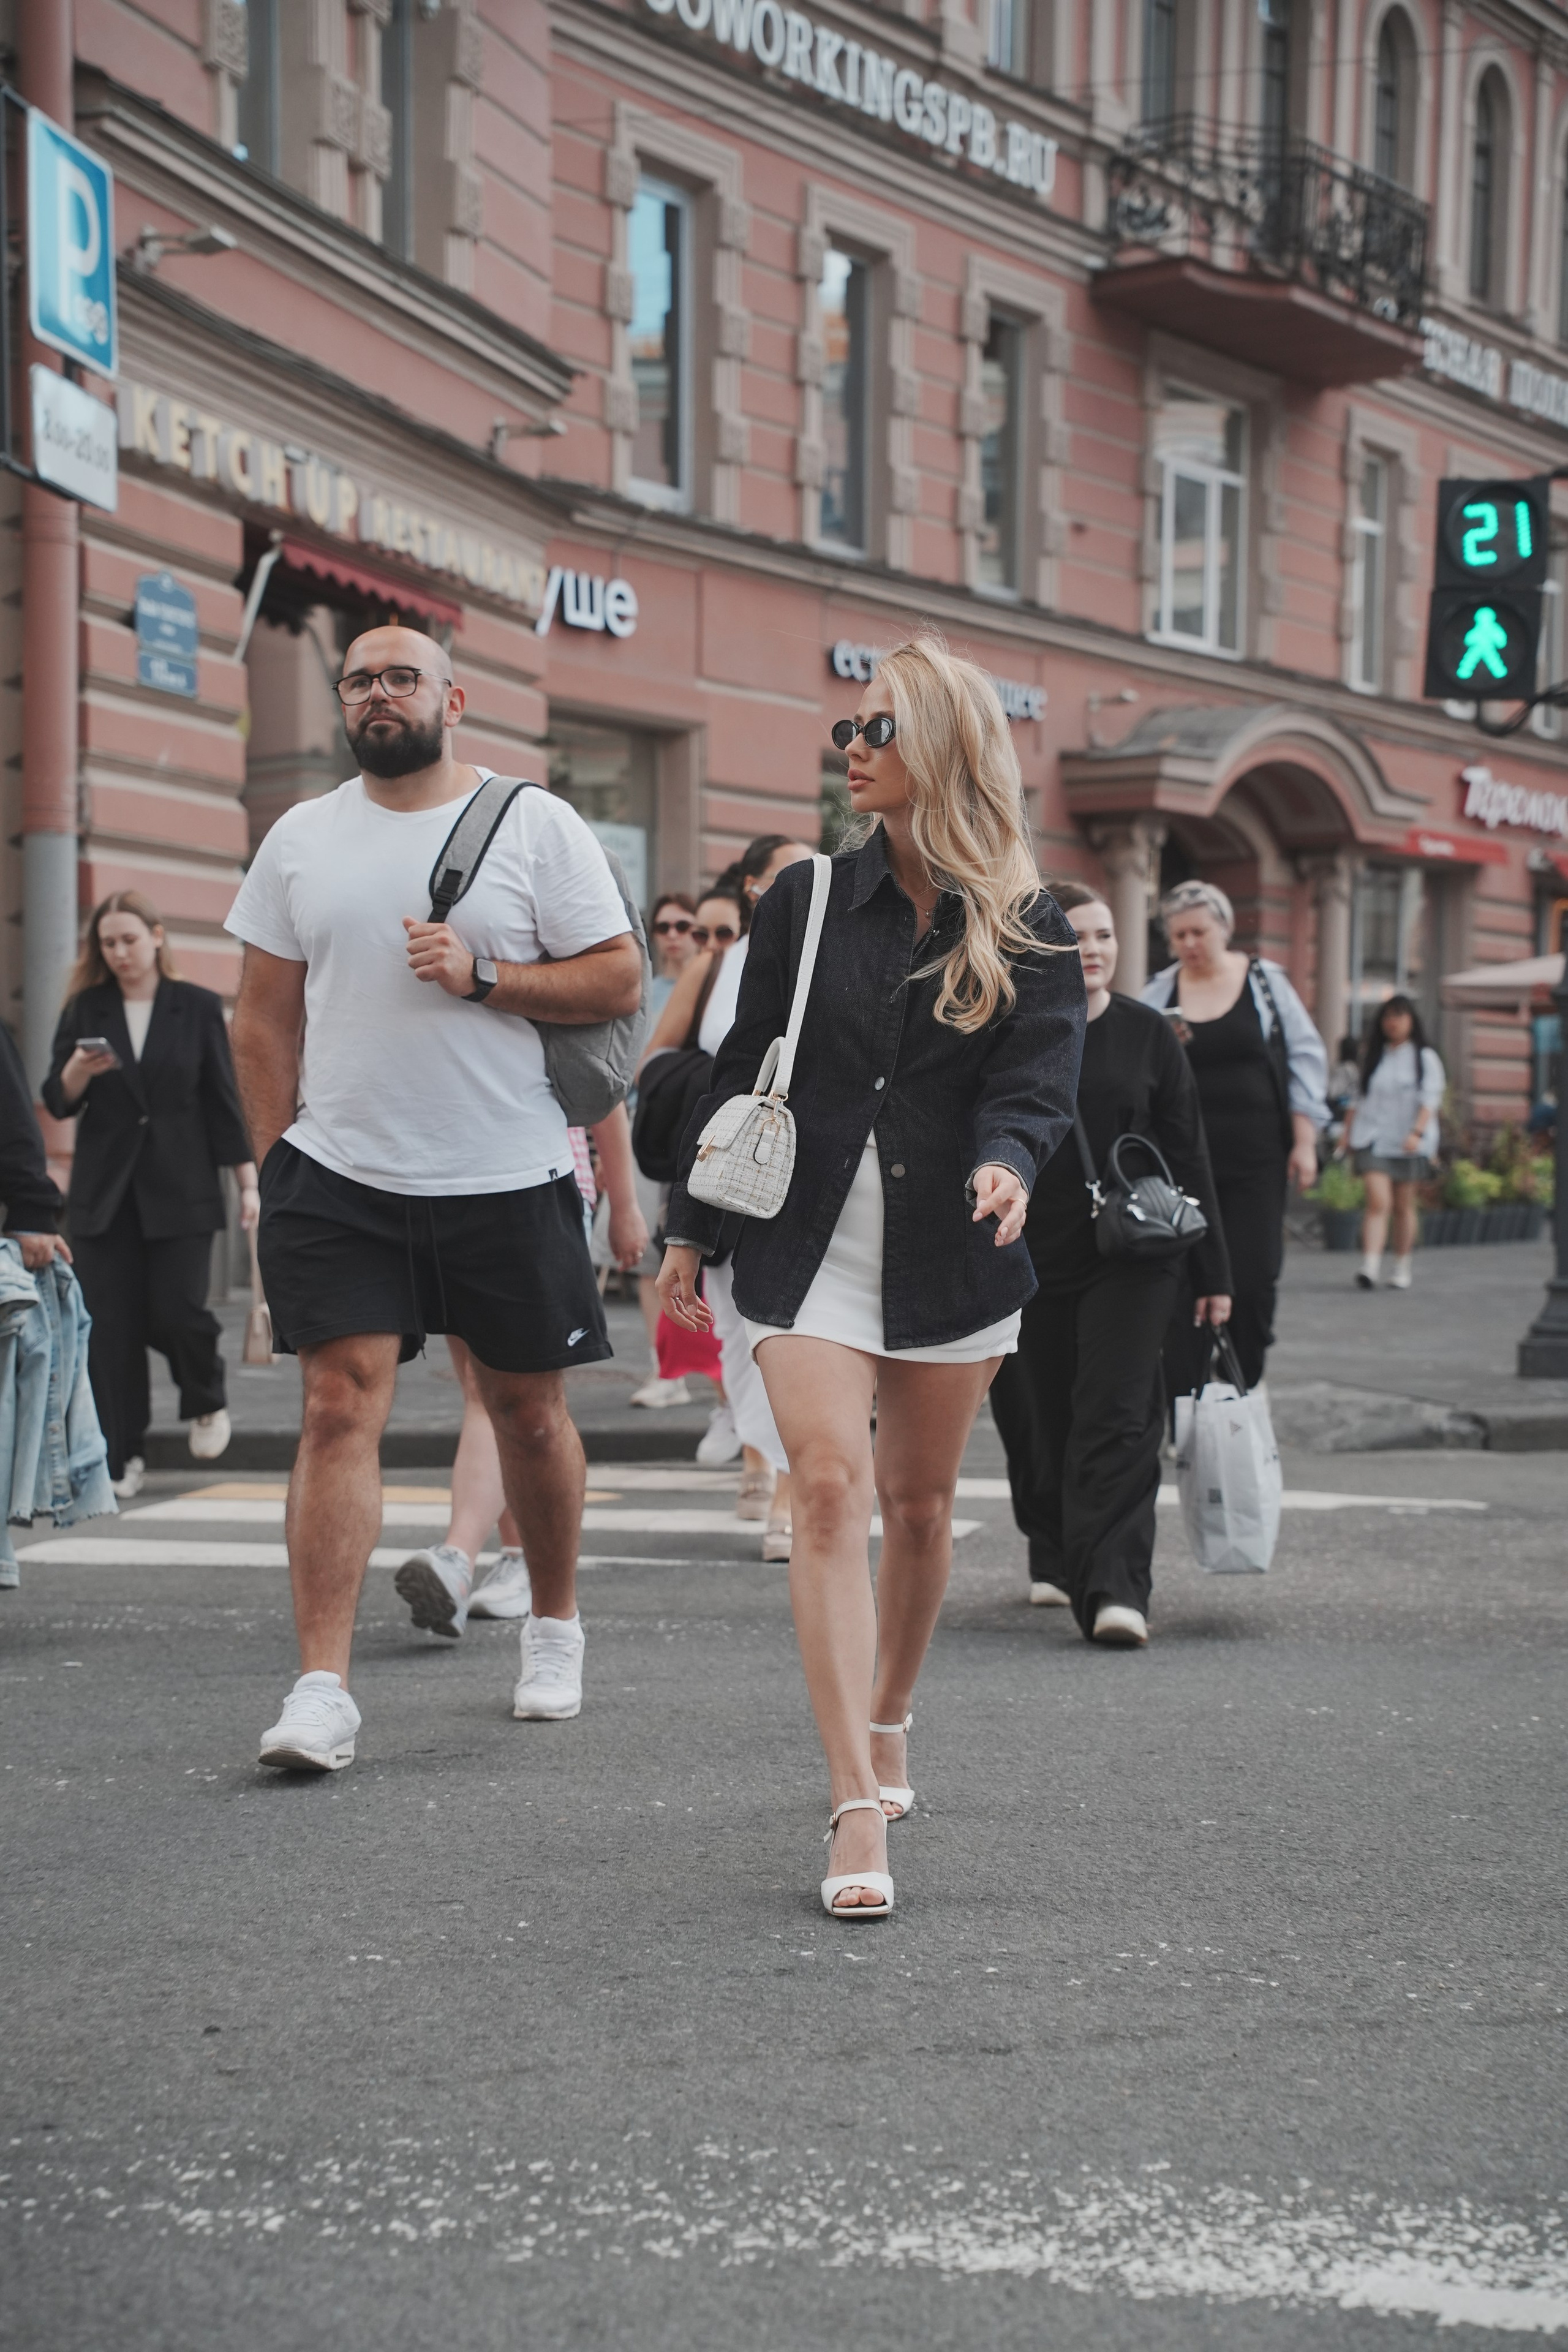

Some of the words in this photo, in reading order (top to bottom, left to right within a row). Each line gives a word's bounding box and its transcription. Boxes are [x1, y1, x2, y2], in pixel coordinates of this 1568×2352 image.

[647, 0, 1058, 194] WORKINGSPB.RU
[123, 382, 288, 516] KETCH
[294, 450, 360, 539] UP
[1462, 501, 1532, 567] 21
